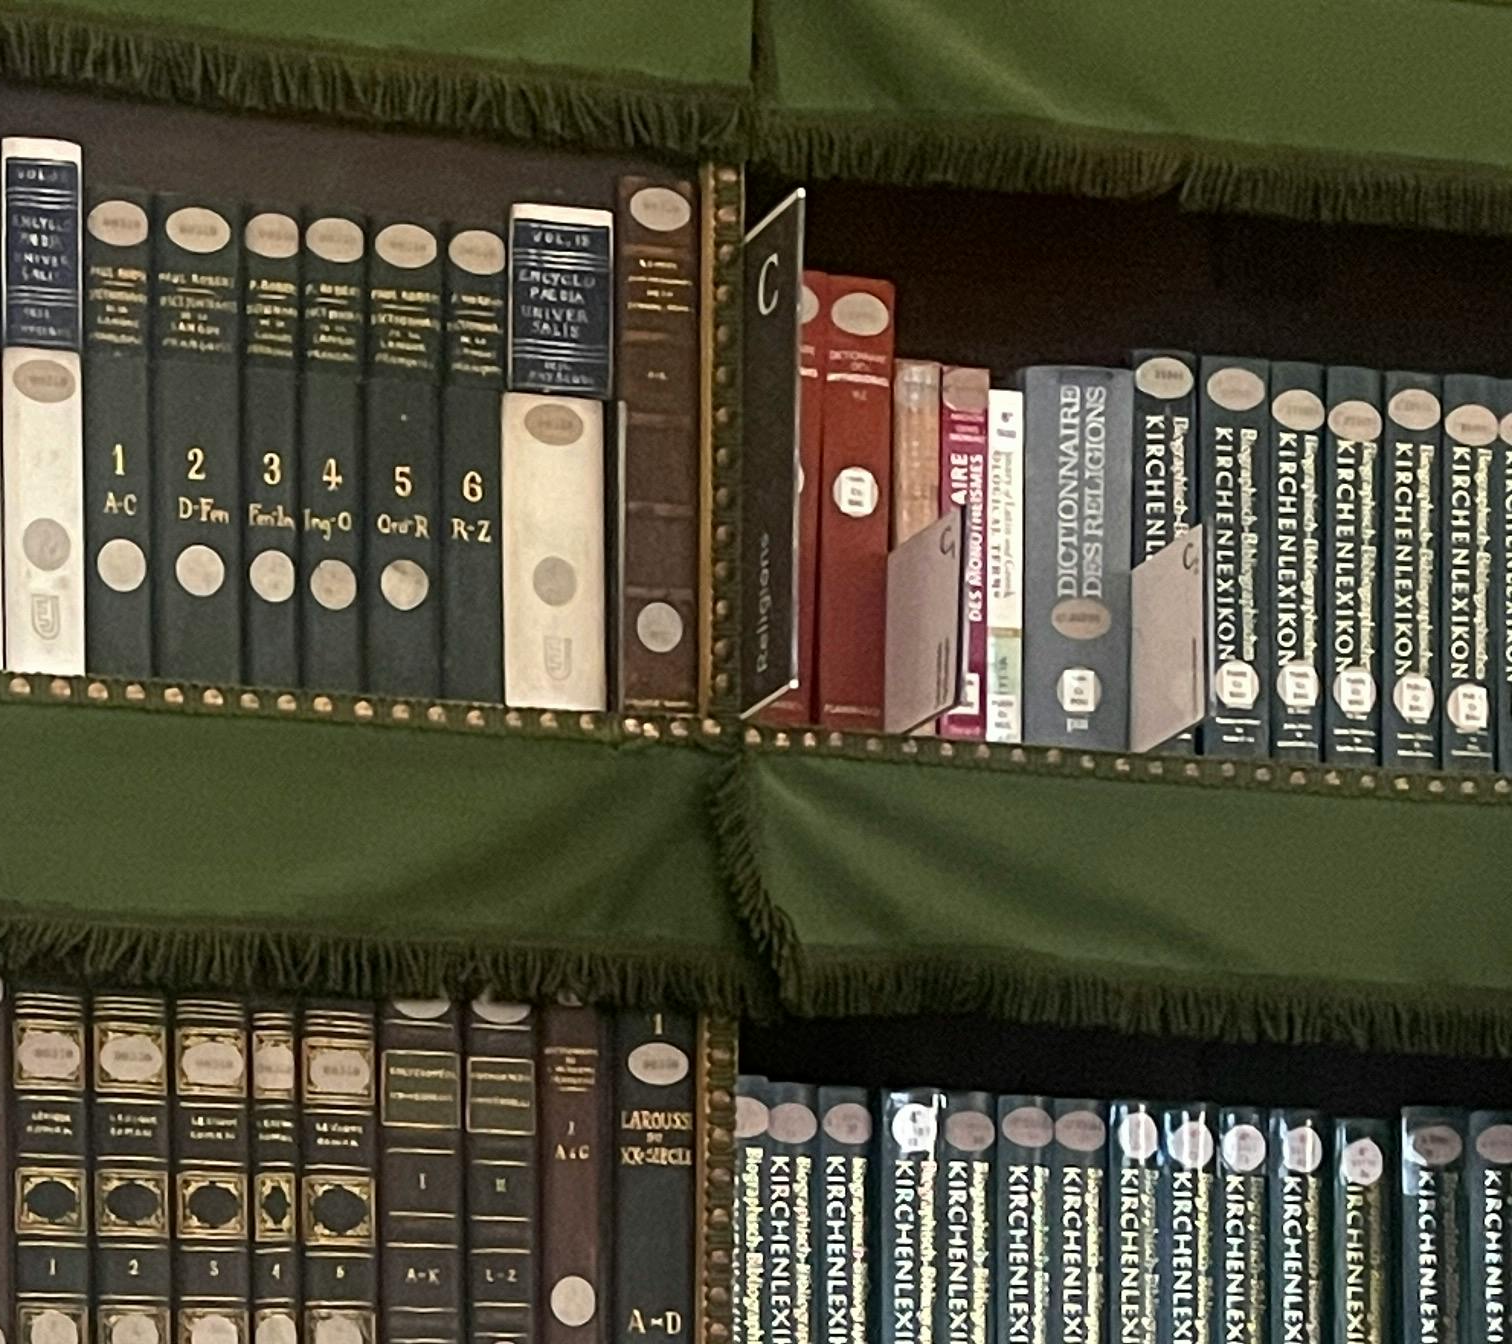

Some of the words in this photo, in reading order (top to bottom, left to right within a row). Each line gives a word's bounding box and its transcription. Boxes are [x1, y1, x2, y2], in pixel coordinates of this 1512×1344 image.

[112, 444, 126, 476] 1
[187, 448, 207, 480] 2
[262, 452, 282, 485] 3
[322, 458, 342, 491] 4
[394, 466, 413, 497] 5
[462, 470, 484, 503] 6
[1084, 385, 1107, 537] RELIGIONS
[1144, 414, 1167, 562] KIRCHENL
[1057, 384, 1081, 598] DICTIONNAIRE
[1082, 542, 1103, 598] DES
[1215, 427, 1238, 661] KIRCHENLEXIKON
[1277, 432, 1298, 667] KIRCHENLEXIKON
[1335, 440, 1356, 674] KIRCHENLEXIKON
[1394, 442, 1416, 675] KIRCHENLEXIKON
[1450, 447, 1471, 679] KIRCHENLEXIKON
[128, 1258, 139, 1275] 2
[628, 1308, 682, 1336] A-D
